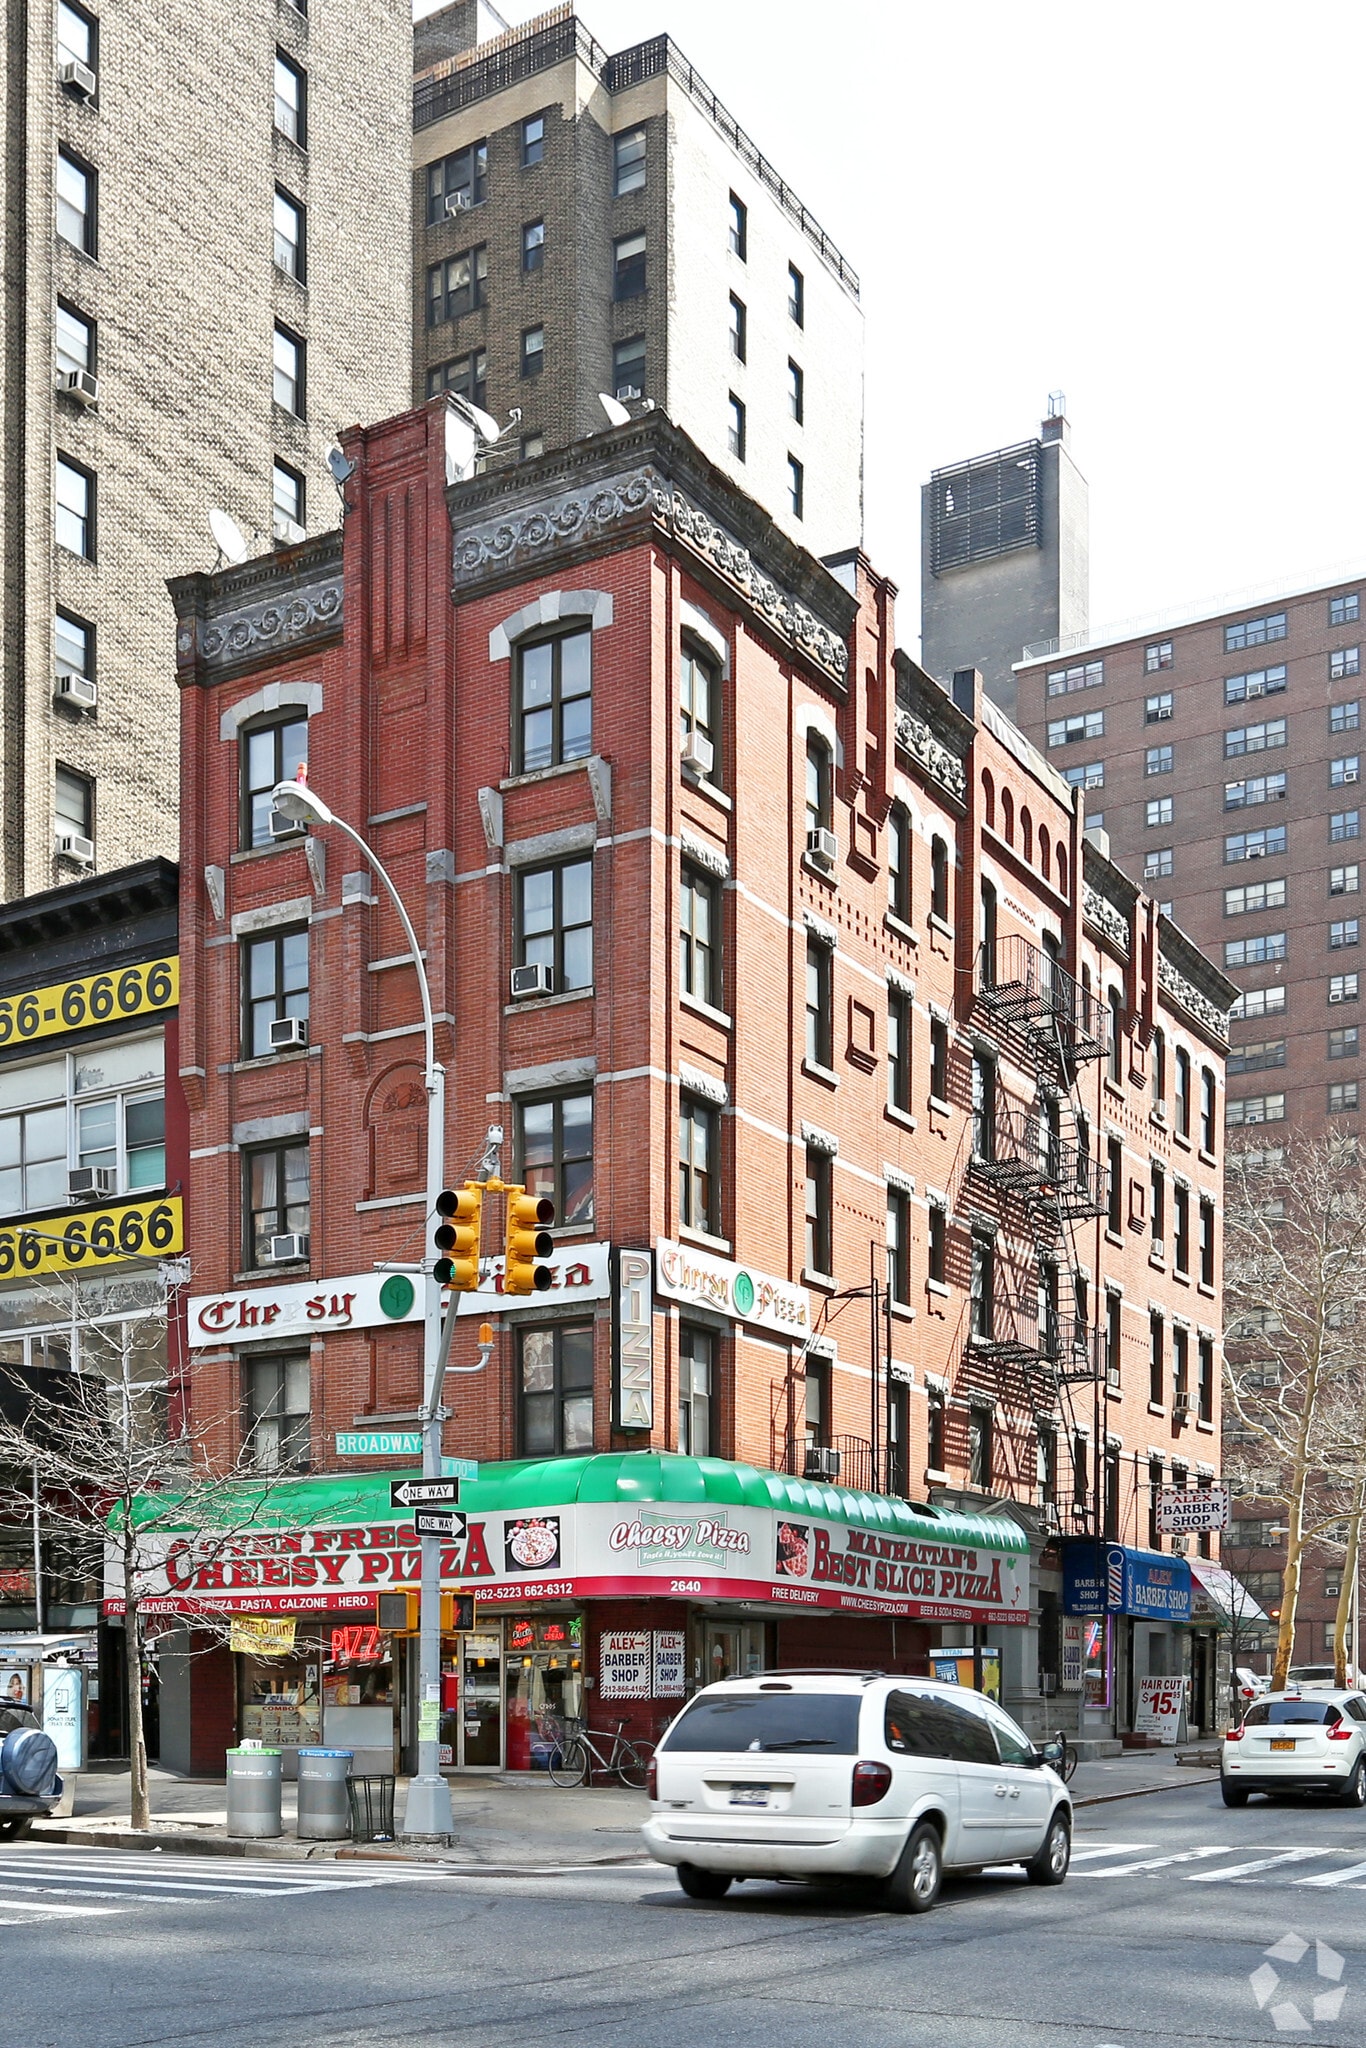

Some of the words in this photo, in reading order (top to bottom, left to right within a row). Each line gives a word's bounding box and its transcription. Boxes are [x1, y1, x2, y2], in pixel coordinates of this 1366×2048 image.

[621, 1255, 651, 1424] PIZZA
[336, 1435, 421, 1452] BROADWAY
[403, 1487, 423, 1499] ONE
[428, 1486, 449, 1498] WAY
[1172, 1494, 1212, 1504] ALEX
[1163, 1502, 1220, 1515] BARBER
[420, 1517, 435, 1529] ONE
[438, 1518, 453, 1530] WAY
[1172, 1515, 1211, 1526] SHOP
[309, 1523, 458, 1554] FRES
[608, 1520, 693, 1552] Cheesy
[696, 1519, 751, 1555] Pizza
[846, 1529, 978, 1572] MANHATTAN'S
[166, 1538, 350, 1592] CHEESY
[811, 1527, 871, 1588] BEST
[875, 1560, 936, 1597] SLICE
[938, 1558, 1003, 1604] PIZZA
[1074, 1579, 1105, 1588] BARBR
[1148, 1567, 1172, 1586] ALEX
[670, 1580, 701, 1592] 2640
[240, 1598, 272, 1610] PASTA
[279, 1597, 328, 1609] CALZONE
[338, 1595, 368, 1607] HERO
[474, 1586, 521, 1600] 662-5223
[524, 1583, 573, 1597] 662-6312
[772, 1587, 789, 1600] FREE
[789, 1589, 820, 1603] DELIVERY
[920, 1605, 935, 1616] BEER
[938, 1607, 952, 1617] SODA
[952, 1608, 973, 1619] SERVED
[1135, 1584, 1167, 1608] BARBER
[1168, 1589, 1188, 1610] SHOP
[261, 1619, 294, 1637] Online
[610, 1637, 635, 1650] ALEX
[660, 1636, 676, 1649] ALEX
[605, 1653, 645, 1667] BARBER
[657, 1652, 681, 1665] BARBER
[611, 1669, 639, 1682] SHOP
[660, 1668, 678, 1681] SHOP
[1063, 1665, 1080, 1681] SHOP
[1141, 1679, 1162, 1690] HAIR
[1163, 1679, 1182, 1690] CUT
